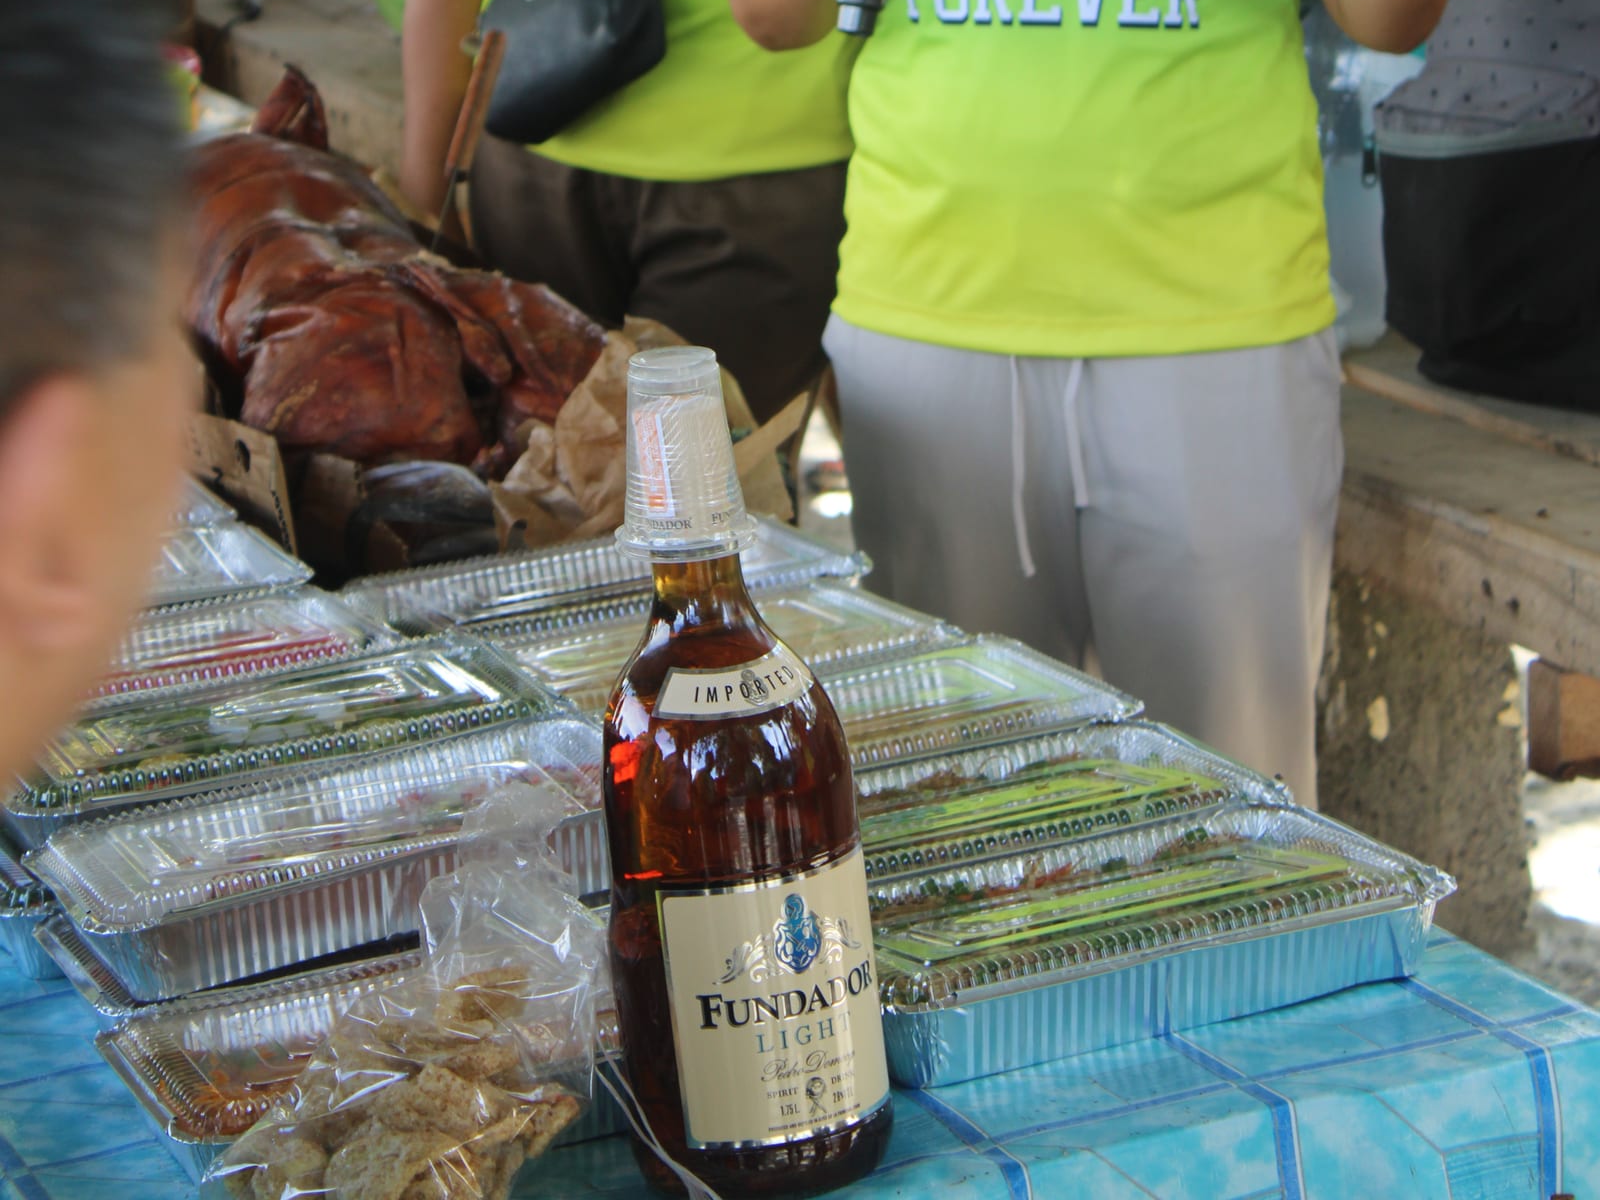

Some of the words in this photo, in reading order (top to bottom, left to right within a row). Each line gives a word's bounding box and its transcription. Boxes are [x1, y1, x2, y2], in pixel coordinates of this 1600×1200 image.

[693, 664, 796, 704] IMPORTED
[695, 959, 874, 1031] FUNDADOR
[756, 1011, 852, 1054] LIGHT
[767, 1087, 799, 1100] SPIRIT
